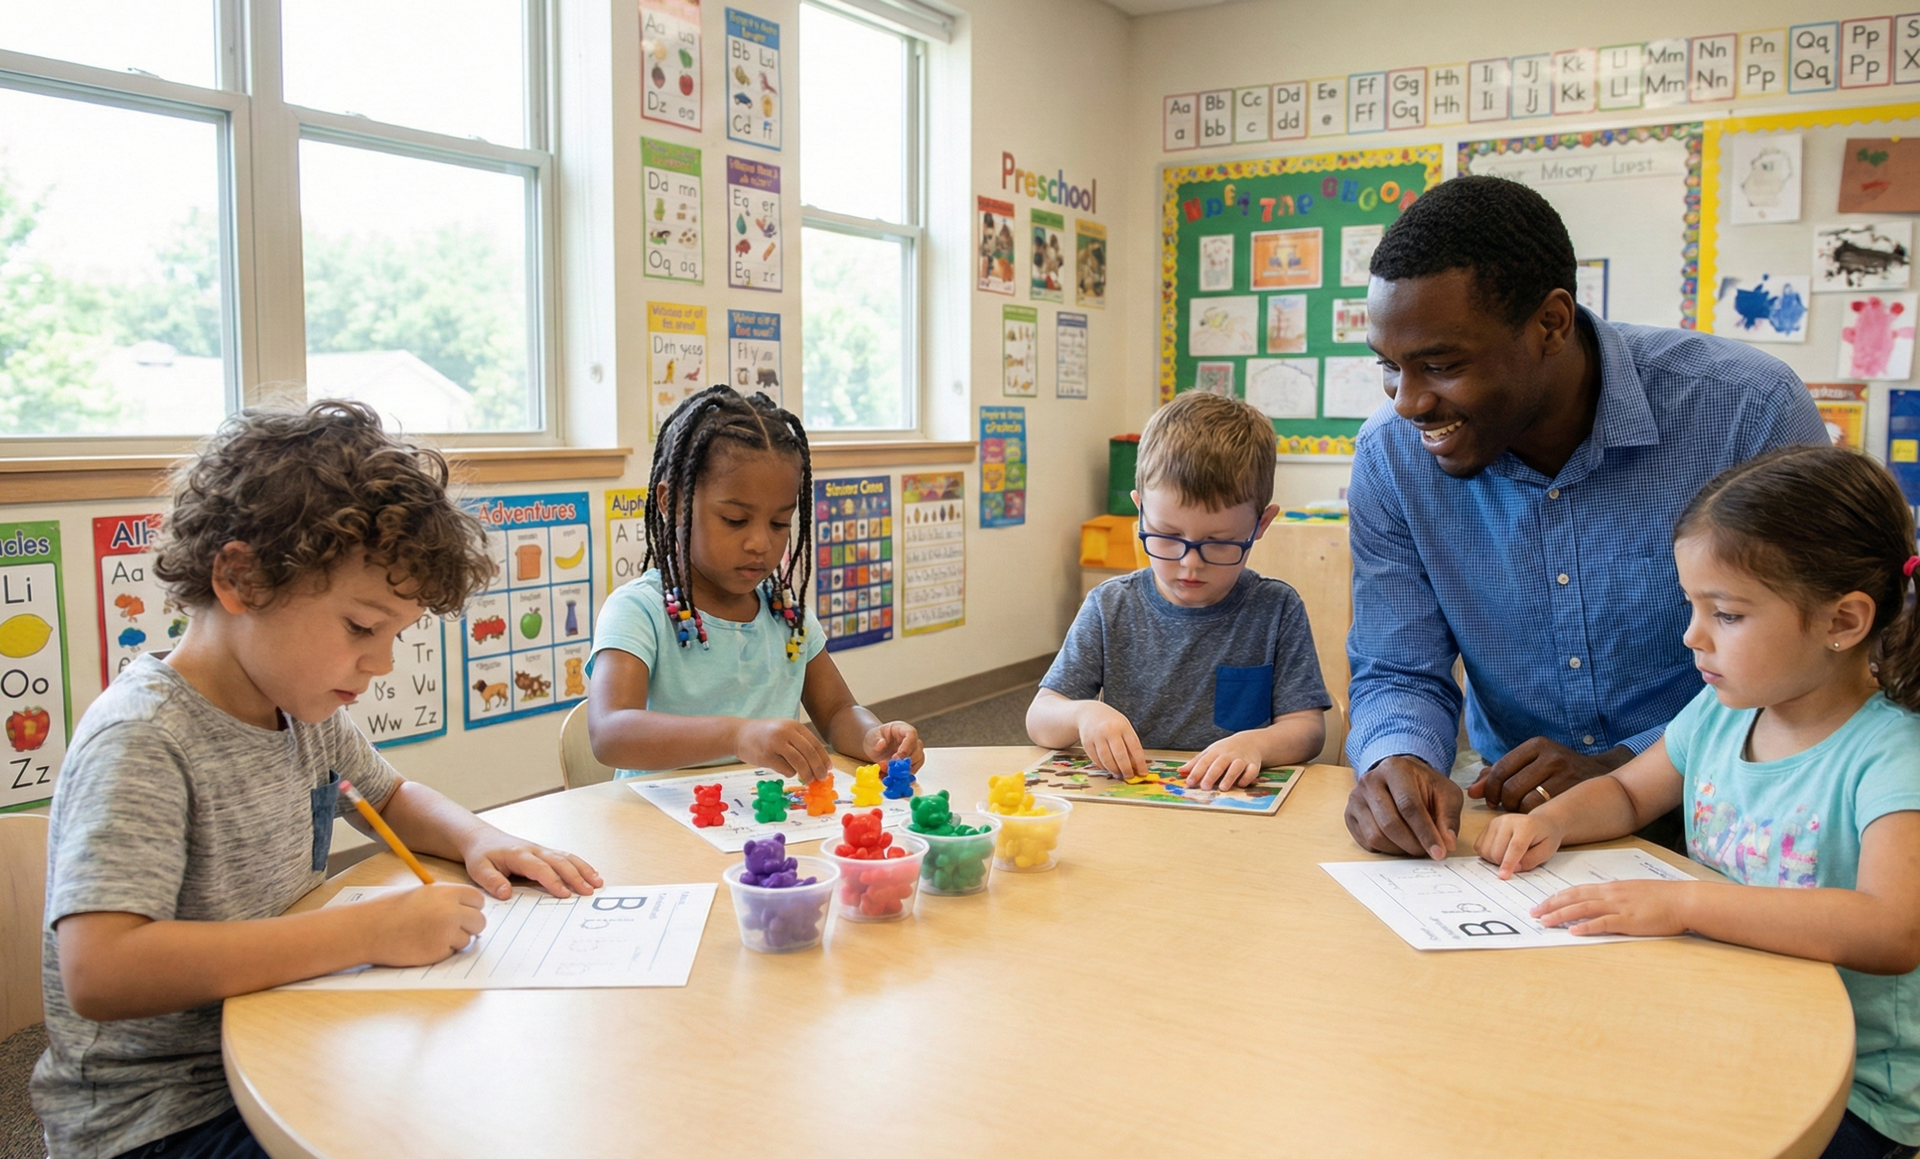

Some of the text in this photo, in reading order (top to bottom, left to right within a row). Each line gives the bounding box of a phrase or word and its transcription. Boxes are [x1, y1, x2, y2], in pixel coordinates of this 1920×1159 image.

[1750, 36, 1775, 54] Pn
[1796, 31, 1830, 54] Qq
[1853, 25, 1880, 50] Pp
[1648, 47, 1684, 64] Mm
[1699, 40, 1727, 60] Nn
[1523, 60, 1539, 84] Jj
[1563, 55, 1586, 73] Kk
[1794, 59, 1831, 86] Qq
[1850, 54, 1880, 82] Pp
[1357, 77, 1376, 95] Ff
[1393, 74, 1419, 96] Gg
[1435, 70, 1460, 87] Hh
[1646, 74, 1686, 94] Mm
[1697, 69, 1728, 92] Nn
[1746, 64, 1775, 92] Pp
[1241, 91, 1262, 107] Cc
[1277, 86, 1300, 104] Dd
[1318, 83, 1337, 100] Ee
[1526, 88, 1538, 114] Jj
[1562, 82, 1586, 103] Kk
[1170, 100, 1191, 115] Aa
[1205, 95, 1225, 111] Bb
[1355, 102, 1376, 122] Ff
[1434, 95, 1460, 115] Hh
[1204, 119, 1226, 137] bb
[1246, 122, 1256, 133] c
[1277, 111, 1300, 130] dd
[1322, 114, 1332, 126] e
[1174, 128, 1185, 140] a
[1002, 150, 1096, 215] Preschool
[479, 501, 576, 524] Adventures
[616, 524, 628, 544] A
[111, 561, 144, 585] Aa
[4, 574, 32, 604] Li
[412, 642, 433, 664] Tr
[1, 669, 49, 698] Oo
[412, 674, 436, 696] Vu
[368, 713, 402, 734] Ww
[414, 706, 437, 727] Zz
[10, 758, 51, 789] Zz
[592, 896, 648, 911] B
[1458, 920, 1521, 937] B
